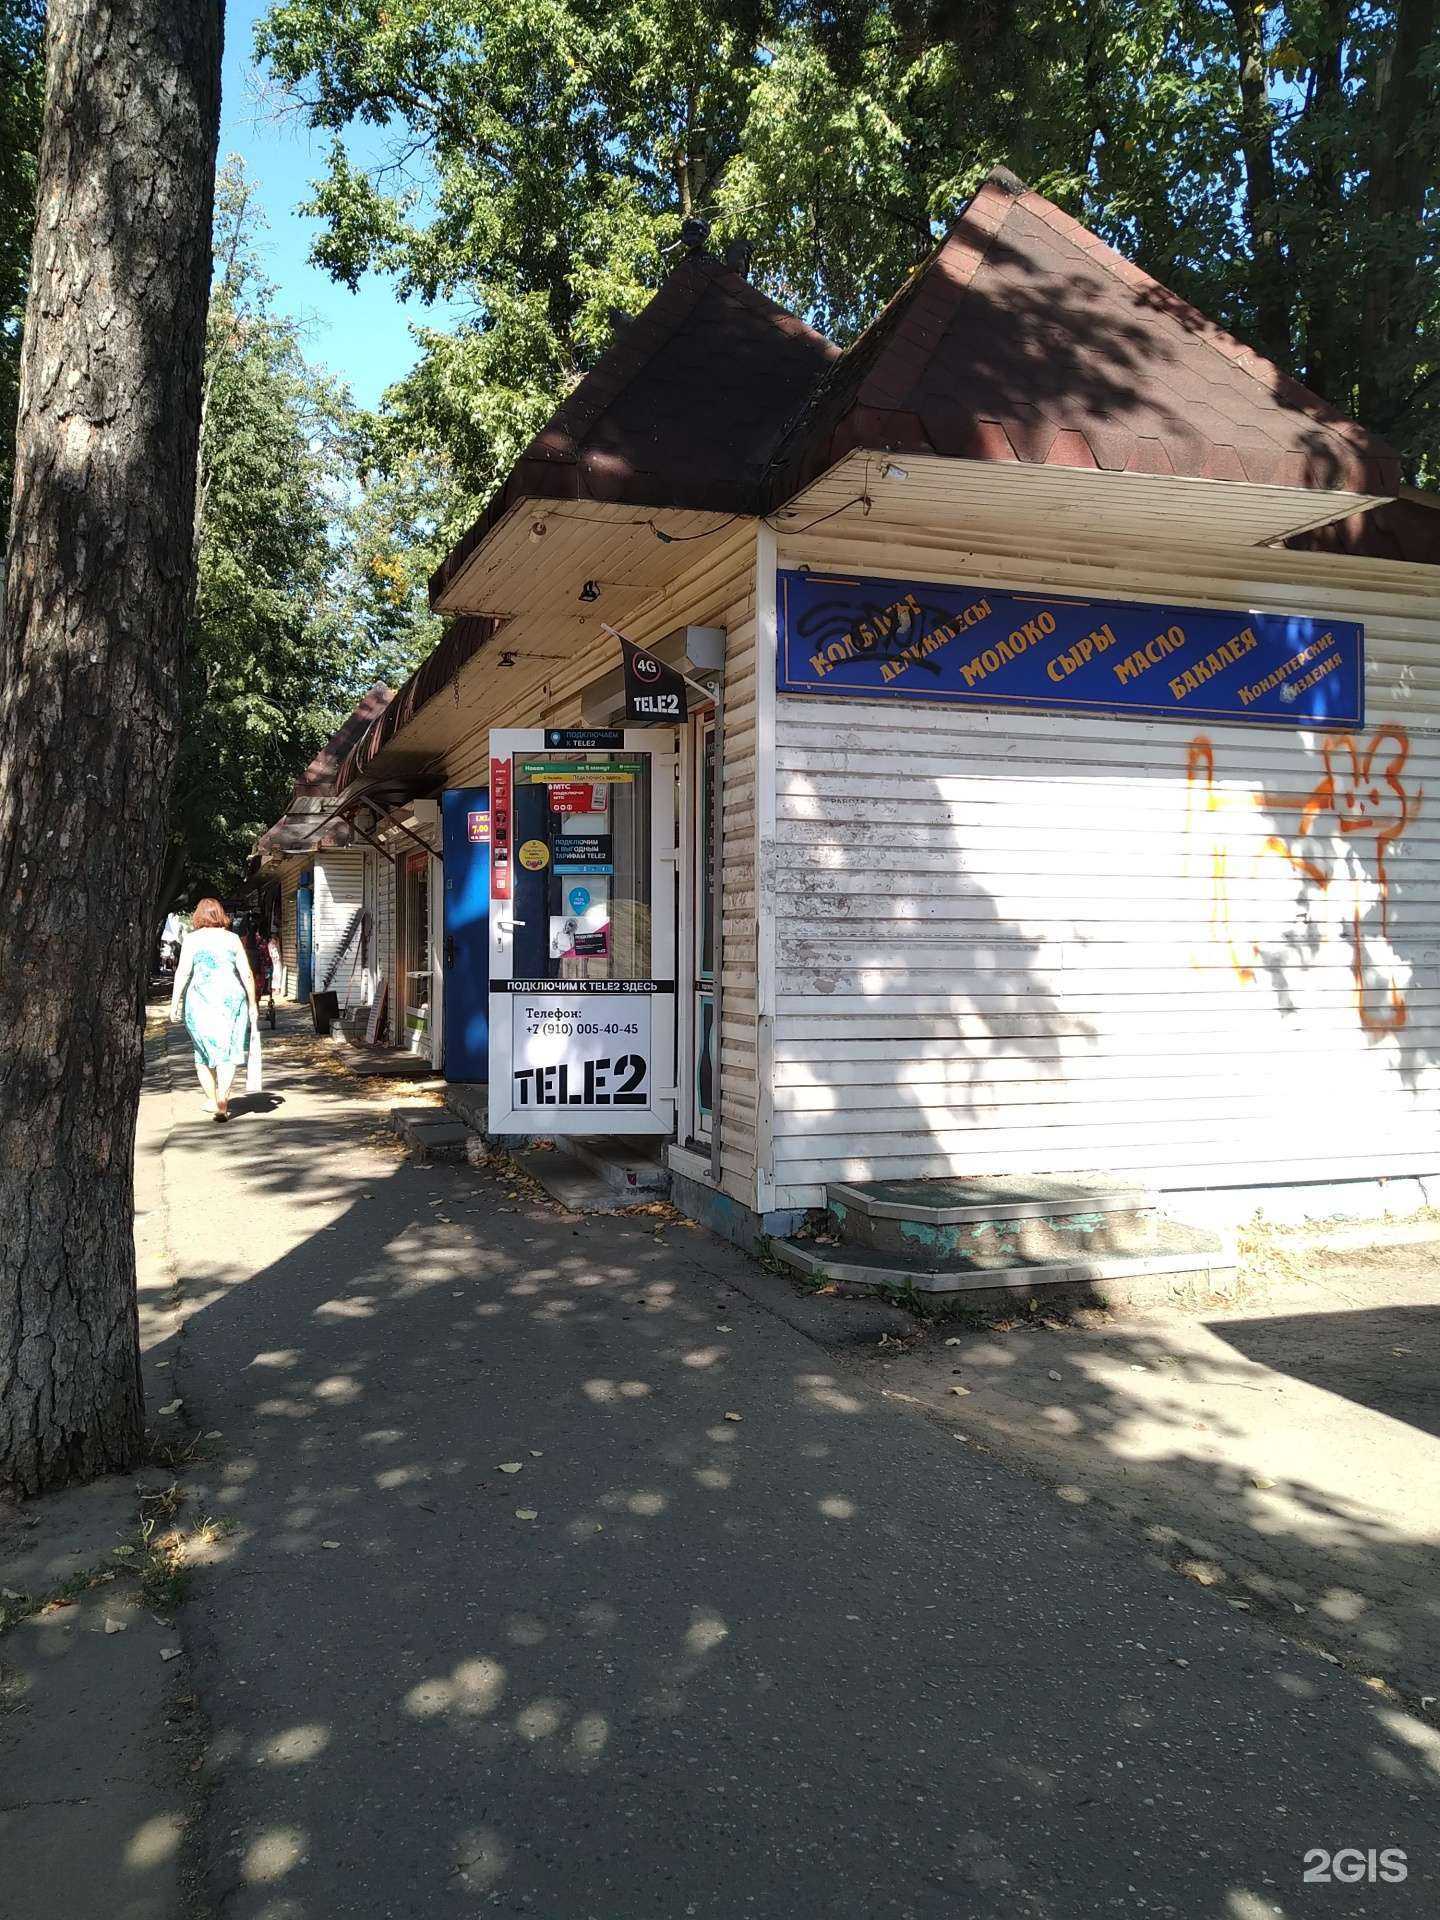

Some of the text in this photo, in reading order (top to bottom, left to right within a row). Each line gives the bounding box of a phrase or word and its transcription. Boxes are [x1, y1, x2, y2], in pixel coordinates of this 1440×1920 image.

[960, 611, 1056, 687] МОЛОКО
[1047, 623, 1117, 682] СЫРЫ
[1113, 625, 1186, 685] МАСЛО
[637, 658, 657, 673] 4G
[1167, 627, 1258, 701] БАКАЛЕЯ
[633, 693, 680, 715] TELE2
[573, 739, 596, 748] TELE2
[507, 981, 658, 992] ПОДКЛЮЧИМ К TELE2 ЗДЕСЬ
[525, 1007, 582, 1021] Телефон:
[526, 1023, 639, 1036] +7 (910) 005-40-45
[514, 1054, 647, 1105] TELE2
